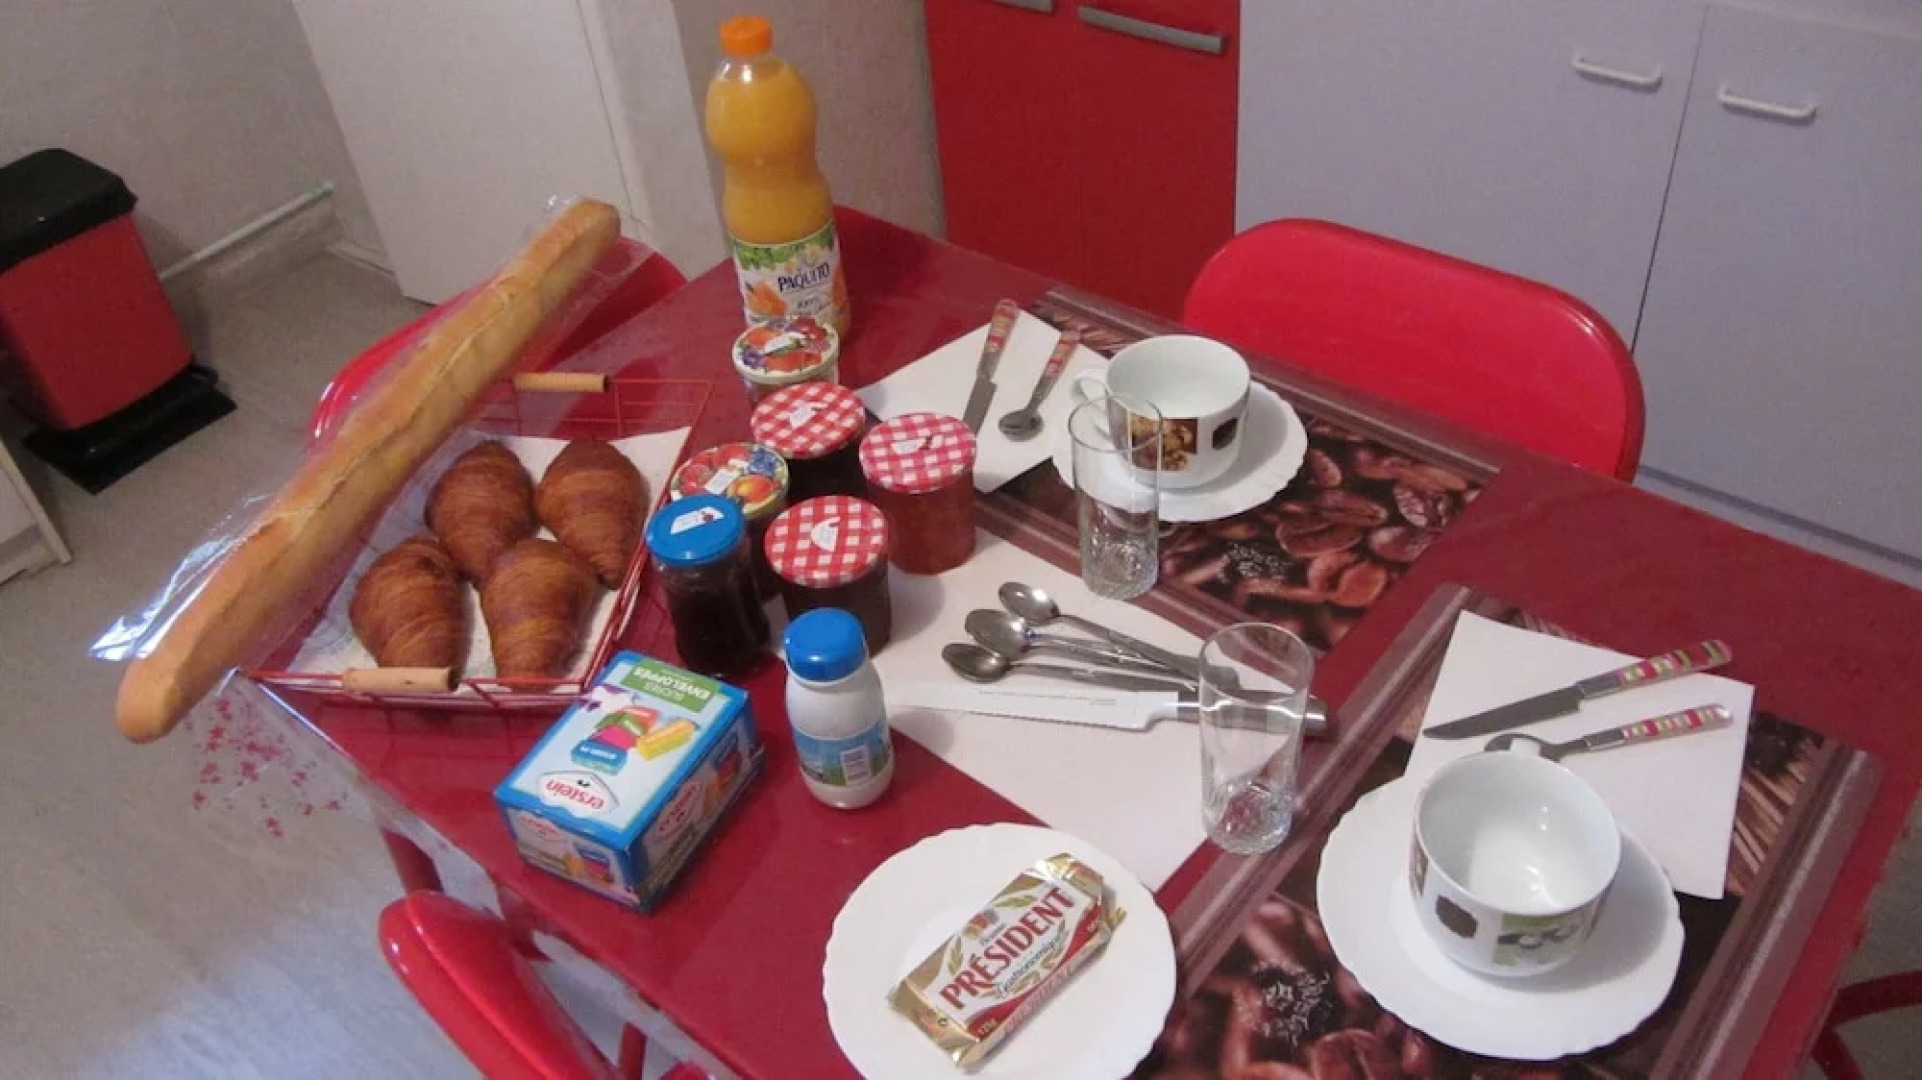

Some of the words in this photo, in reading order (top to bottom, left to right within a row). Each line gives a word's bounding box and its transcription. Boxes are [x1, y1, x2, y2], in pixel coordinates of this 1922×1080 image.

[778, 261, 830, 293] PAQUITO
[545, 779, 604, 810] erstein
[939, 886, 1076, 1010] PRÉSIDENT
